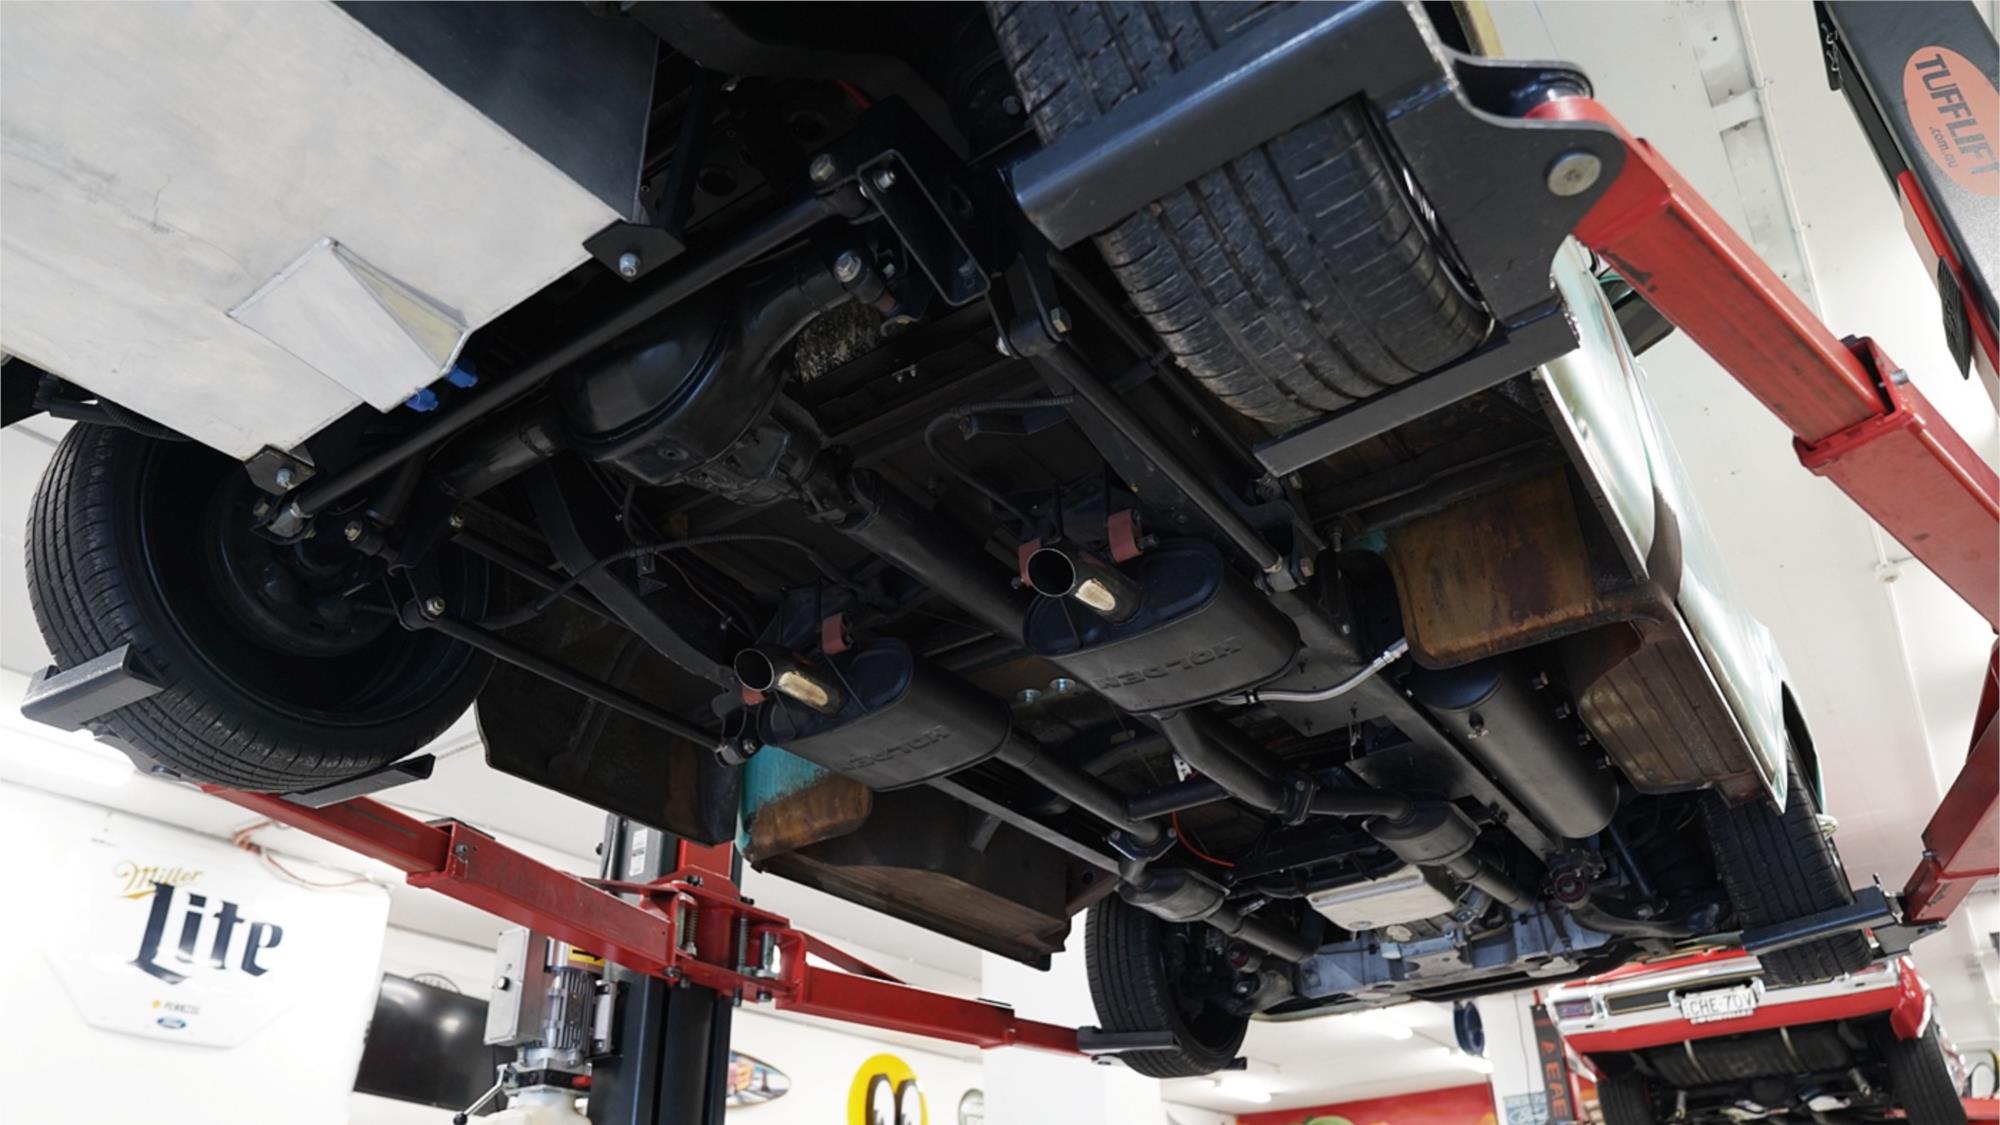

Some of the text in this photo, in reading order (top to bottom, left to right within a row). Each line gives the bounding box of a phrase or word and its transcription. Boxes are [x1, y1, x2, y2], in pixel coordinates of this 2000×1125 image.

[1915, 53, 1999, 175] TUFFLIFT
[1096, 640, 1242, 690] HOLDEN
[112, 860, 205, 896] Miller
[127, 881, 283, 985] Lite
